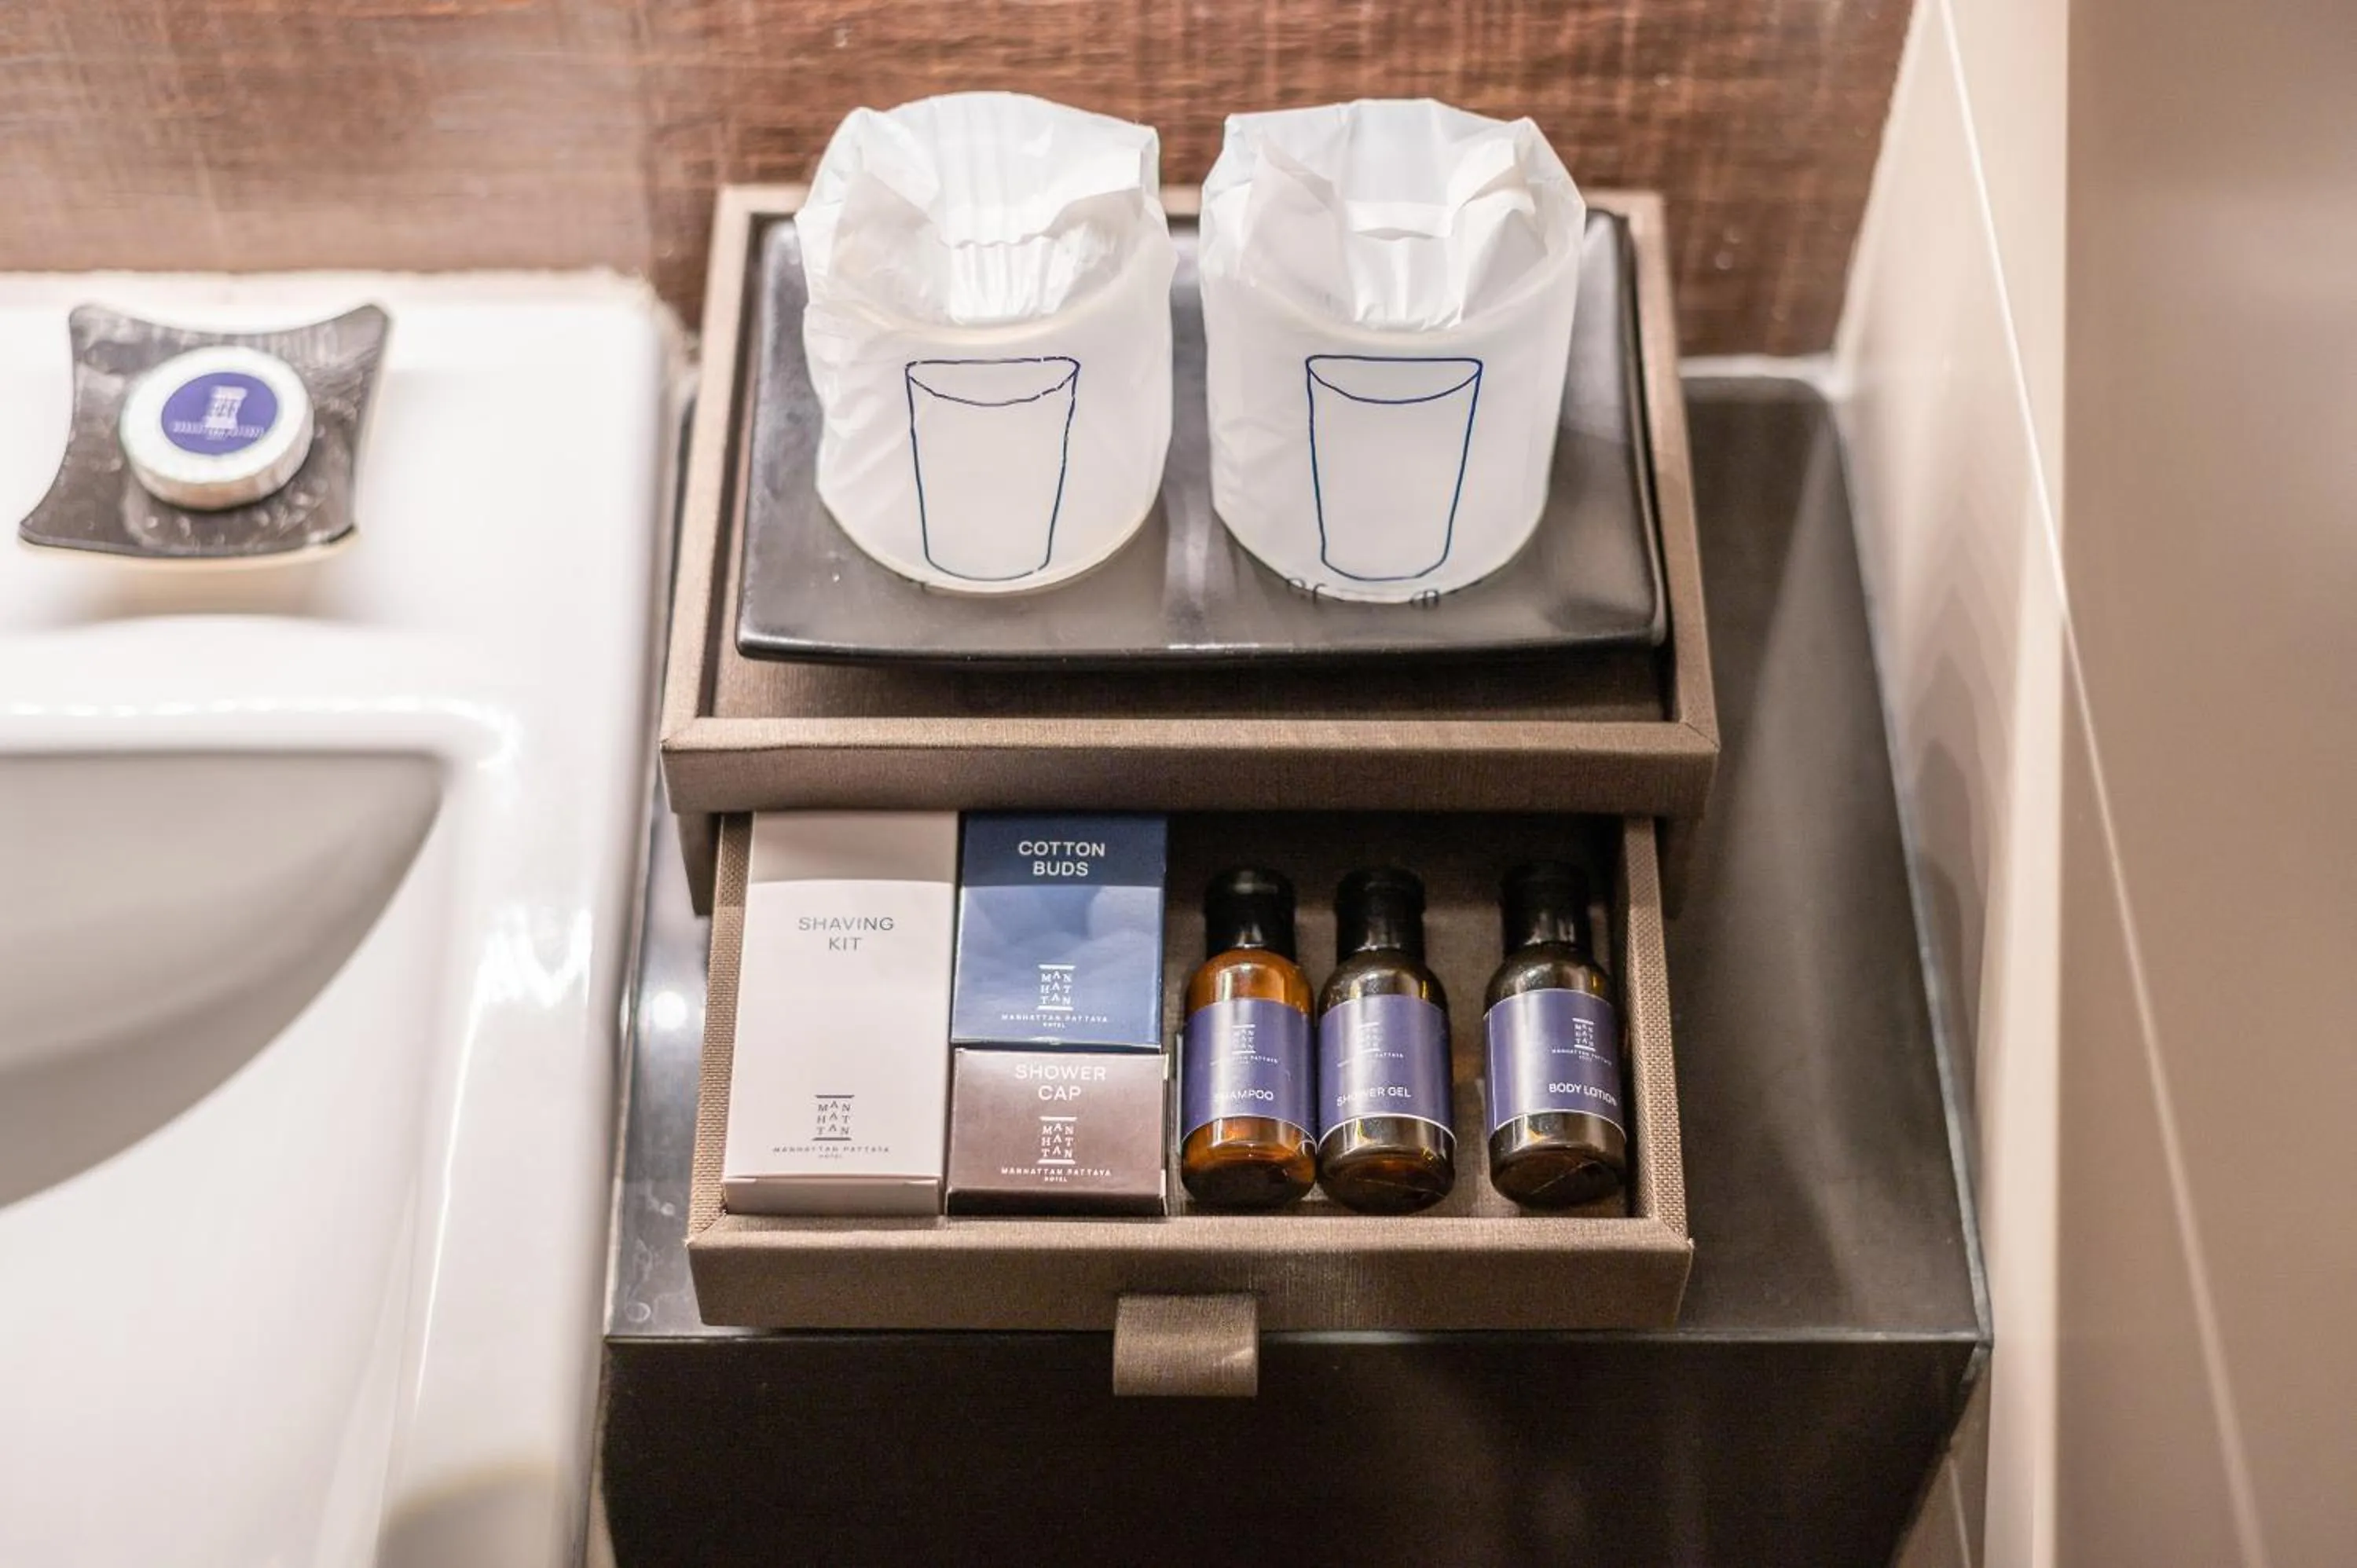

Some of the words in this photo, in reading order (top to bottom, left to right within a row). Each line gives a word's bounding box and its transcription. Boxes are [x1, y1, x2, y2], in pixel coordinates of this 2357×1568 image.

[1018, 841, 1105, 856] COTTON
[1032, 860, 1088, 876] BUDS
[798, 916, 894, 931] SHAVING
[829, 936, 863, 951] KIT
[1015, 1064, 1106, 1081] SHOWER
[1038, 1085, 1081, 1101] CAP
[1387, 1086, 1411, 1097] GEL
[1549, 1083, 1582, 1094] BODY
[1583, 1085, 1617, 1106] LOTION
[818, 1101, 851, 1112] MAN
[817, 1112, 850, 1123] HAT
[816, 1124, 849, 1135] TAN
[1042, 1123, 1074, 1135] MAN
[1041, 1134, 1074, 1146] HAT
[1041, 1145, 1072, 1158] TAN
